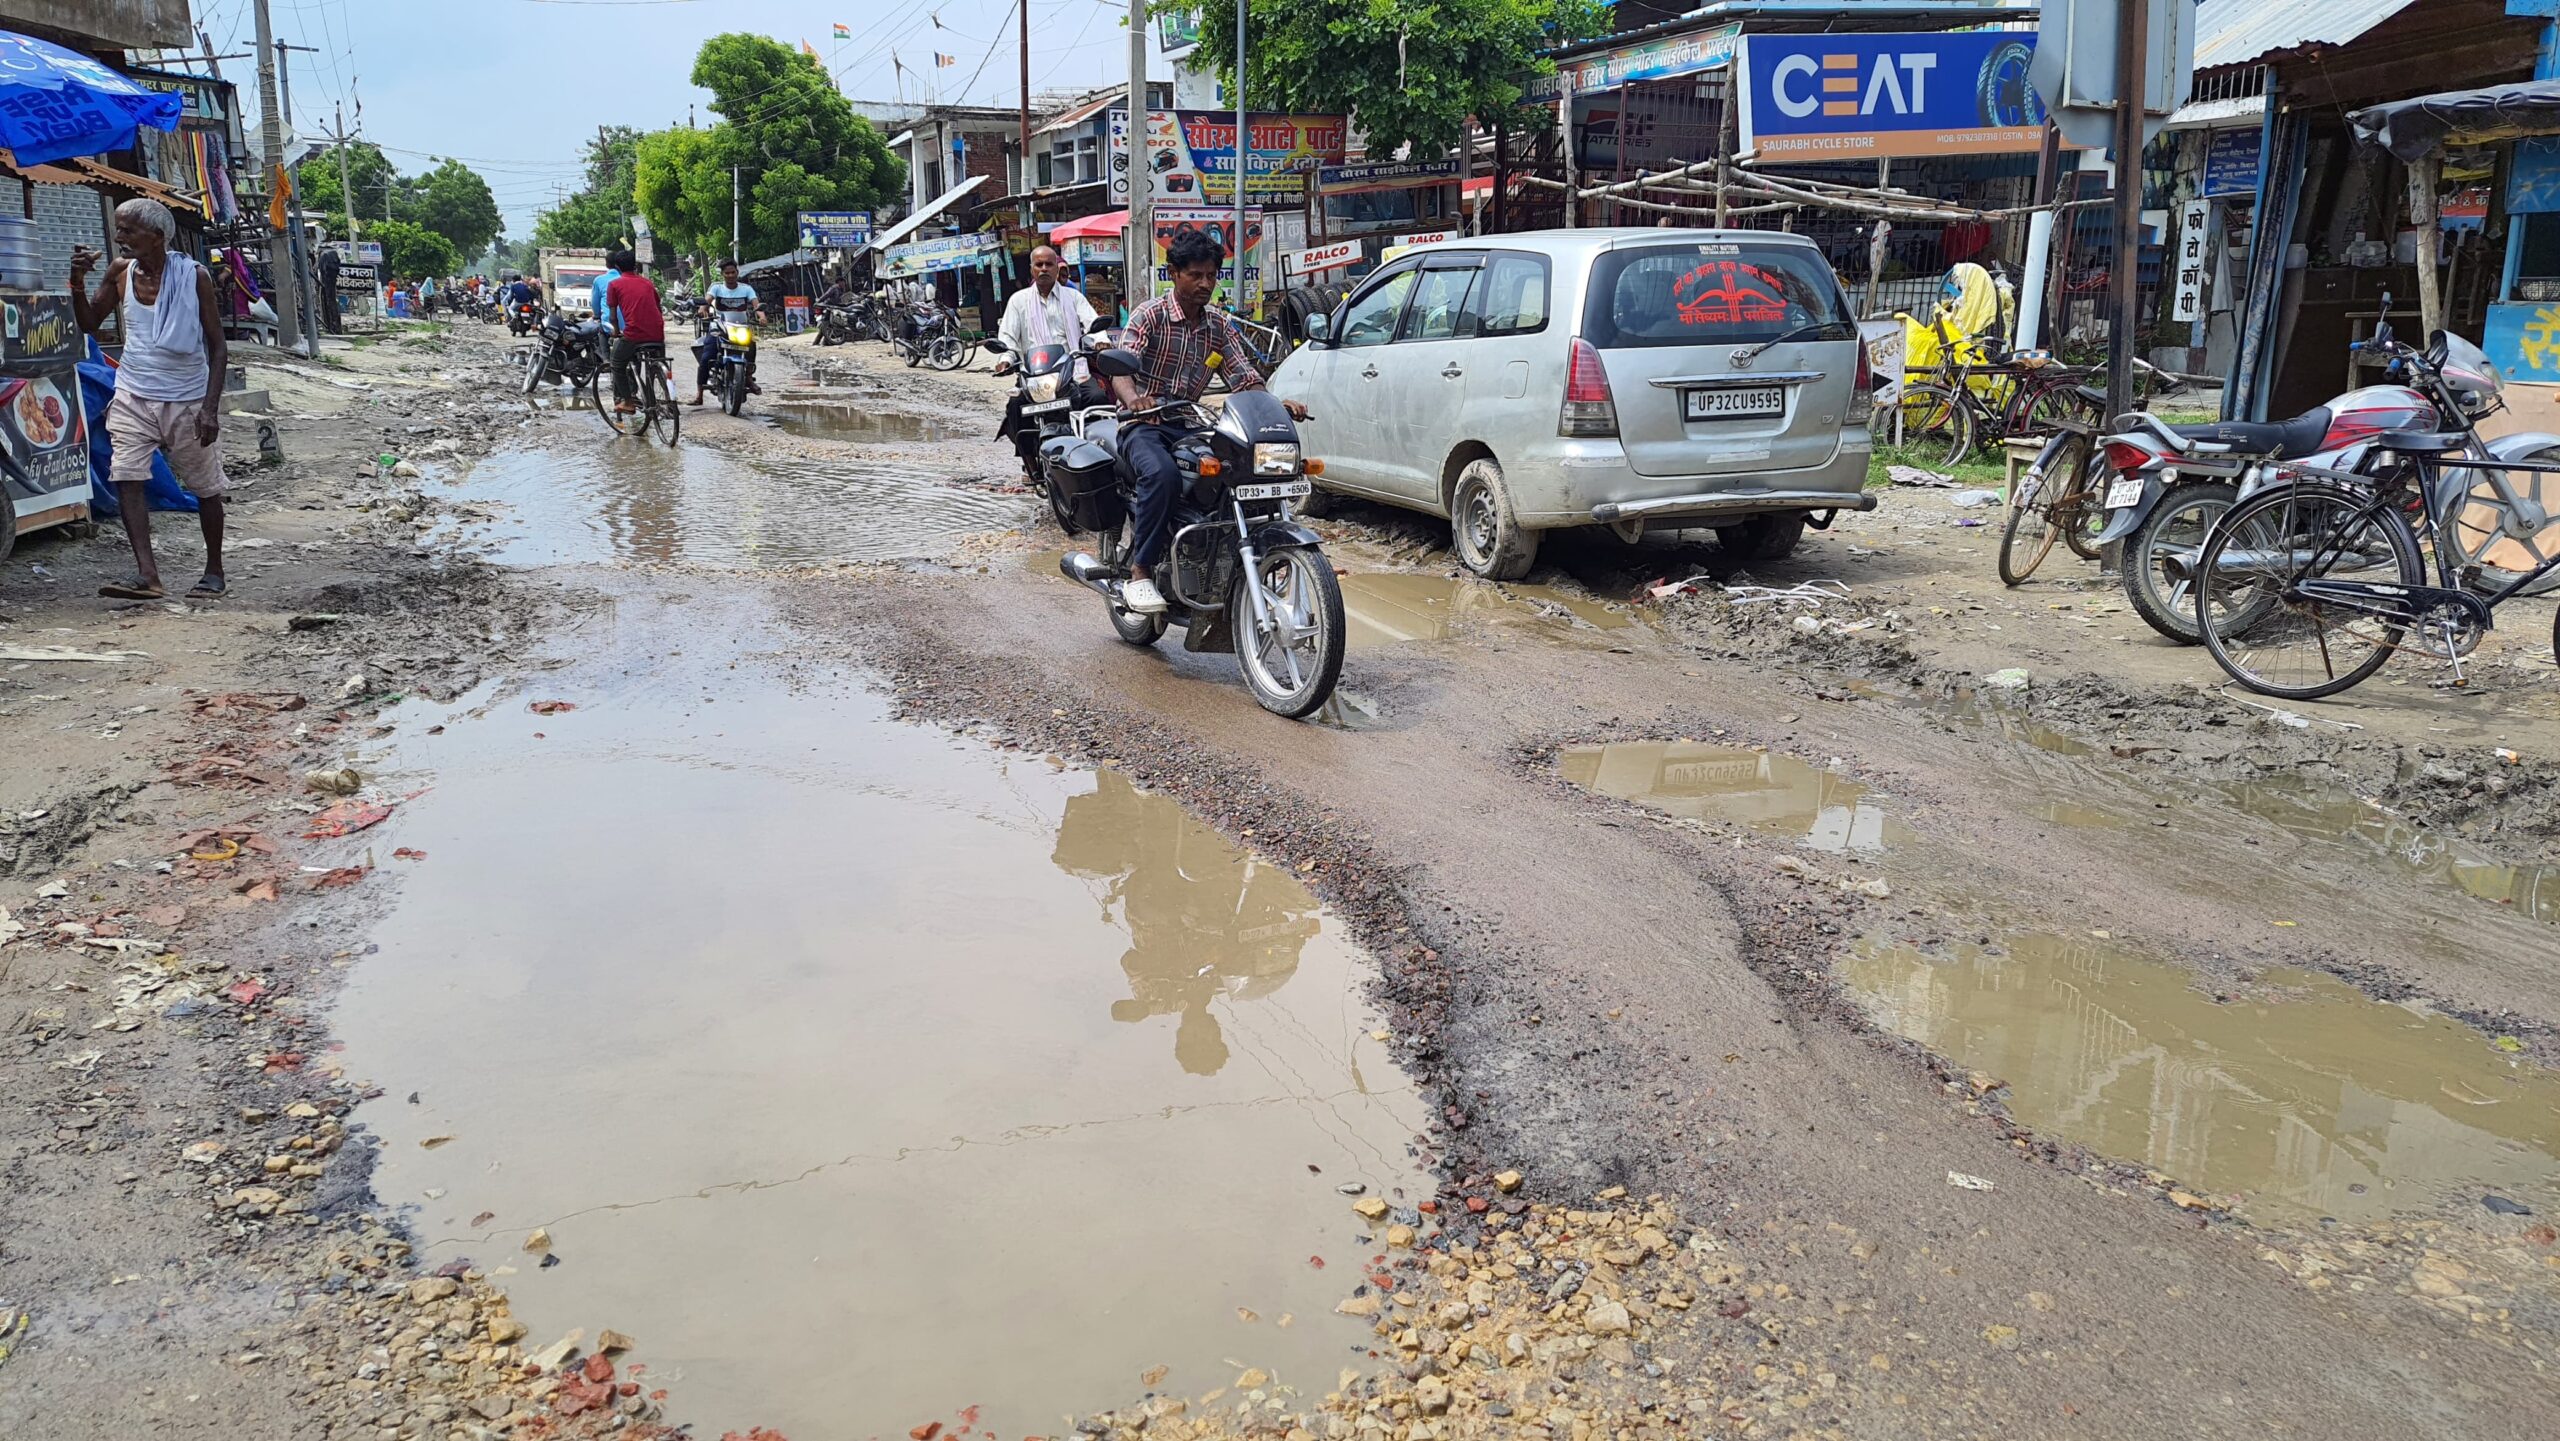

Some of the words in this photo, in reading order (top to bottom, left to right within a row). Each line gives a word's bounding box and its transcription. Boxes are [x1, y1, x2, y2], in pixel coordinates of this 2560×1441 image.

[1634, 48, 1656, 71] मोटर
[1772, 52, 1937, 118] CEAT
[1111, 112, 1129, 121] TV
[1249, 118, 1298, 151] आटो
[1304, 118, 1346, 151] पार्ट
[1147, 139, 1177, 147] ero
[1762, 138, 1811, 152] SAURABH
[1812, 137, 1843, 150] CYCLE
[1843, 136, 1875, 149] STORE
[1203, 156, 1213, 168] &
[1408, 234, 1445, 245] RALCO
[1304, 245, 1350, 264] RALCO
[338, 266, 375, 278] कमला
[1698, 392, 1780, 411] UP32CU9595
[1271, 486, 1282, 497] BB
[1291, 484, 1310, 495] 6506
